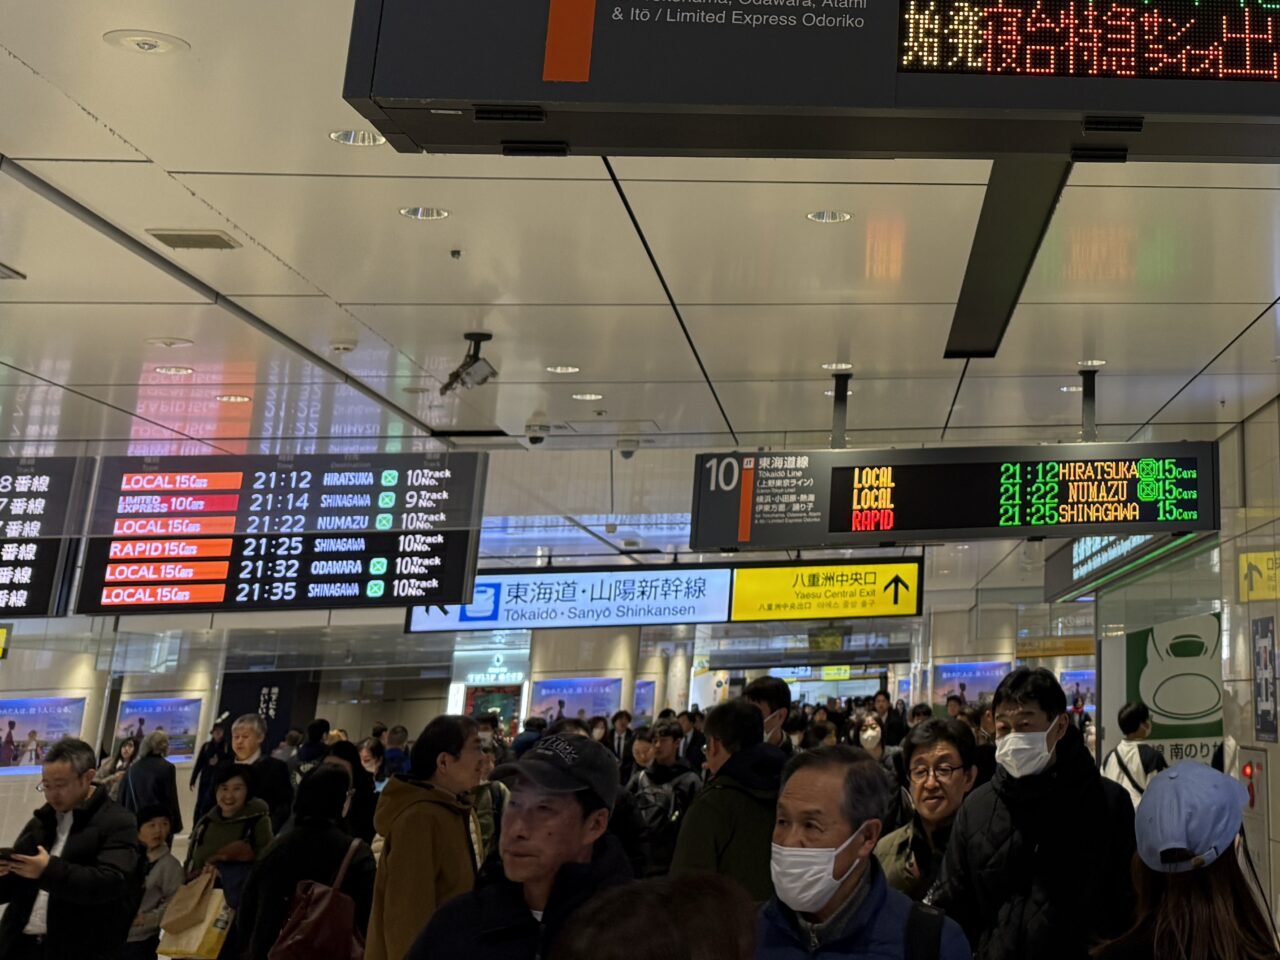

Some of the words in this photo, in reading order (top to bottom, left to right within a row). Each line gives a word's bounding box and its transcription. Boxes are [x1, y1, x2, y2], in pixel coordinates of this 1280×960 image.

[612, 7, 623, 21] &
[666, 9, 726, 24] Limited
[731, 11, 797, 28] Express
[802, 13, 864, 28] Odoriko
[758, 456, 809, 469] 東海道線
[121, 476, 174, 489] LOCAL
[253, 471, 312, 488] 21:12
[323, 472, 374, 486] HIRATSUKA
[407, 469, 422, 486] 10
[706, 457, 739, 491] 10
[854, 467, 895, 489] LOCAL
[1001, 462, 1059, 483] 21:12
[1059, 462, 1138, 481] HIRATSUKA
[119, 496, 161, 504] LIMITED
[250, 493, 309, 511] 21:14
[321, 494, 371, 507] SHINAGAWA
[405, 492, 417, 508] 9
[853, 488, 895, 510] LOCAL
[1001, 483, 1058, 504] 21:22
[1068, 481, 1128, 502] NUMAZU
[117, 504, 168, 513] EXPRESS
[852, 510, 894, 532] RAPID
[1000, 504, 1058, 526] 21:25
[1059, 503, 1140, 522] SHINAGAWA
[114, 520, 165, 534] LOCAL
[247, 515, 305, 533] 21:22
[317, 516, 369, 530] NUMAZU
[401, 513, 416, 529] 10
[110, 542, 162, 556] RAPID
[243, 537, 303, 556] 21:25
[314, 538, 365, 552] SHINAGAWA
[399, 535, 414, 552] 10
[106, 565, 157, 580] LOCAL
[240, 560, 299, 578] 21:32
[311, 560, 362, 575] ODAWARA
[396, 557, 411, 574] 10
[792, 572, 877, 588] 八重洲中央口
[102, 589, 154, 603] LOCAL
[236, 582, 297, 601] 21:35
[308, 583, 359, 598] SHINAGAWA
[393, 579, 408, 597] 10
[505, 577, 707, 605] 東海道・山陽新幹線
[795, 590, 821, 600] Yaesu
[824, 589, 857, 599] Central
[859, 588, 876, 597] Exit
[616, 604, 695, 617] Shinkansen
